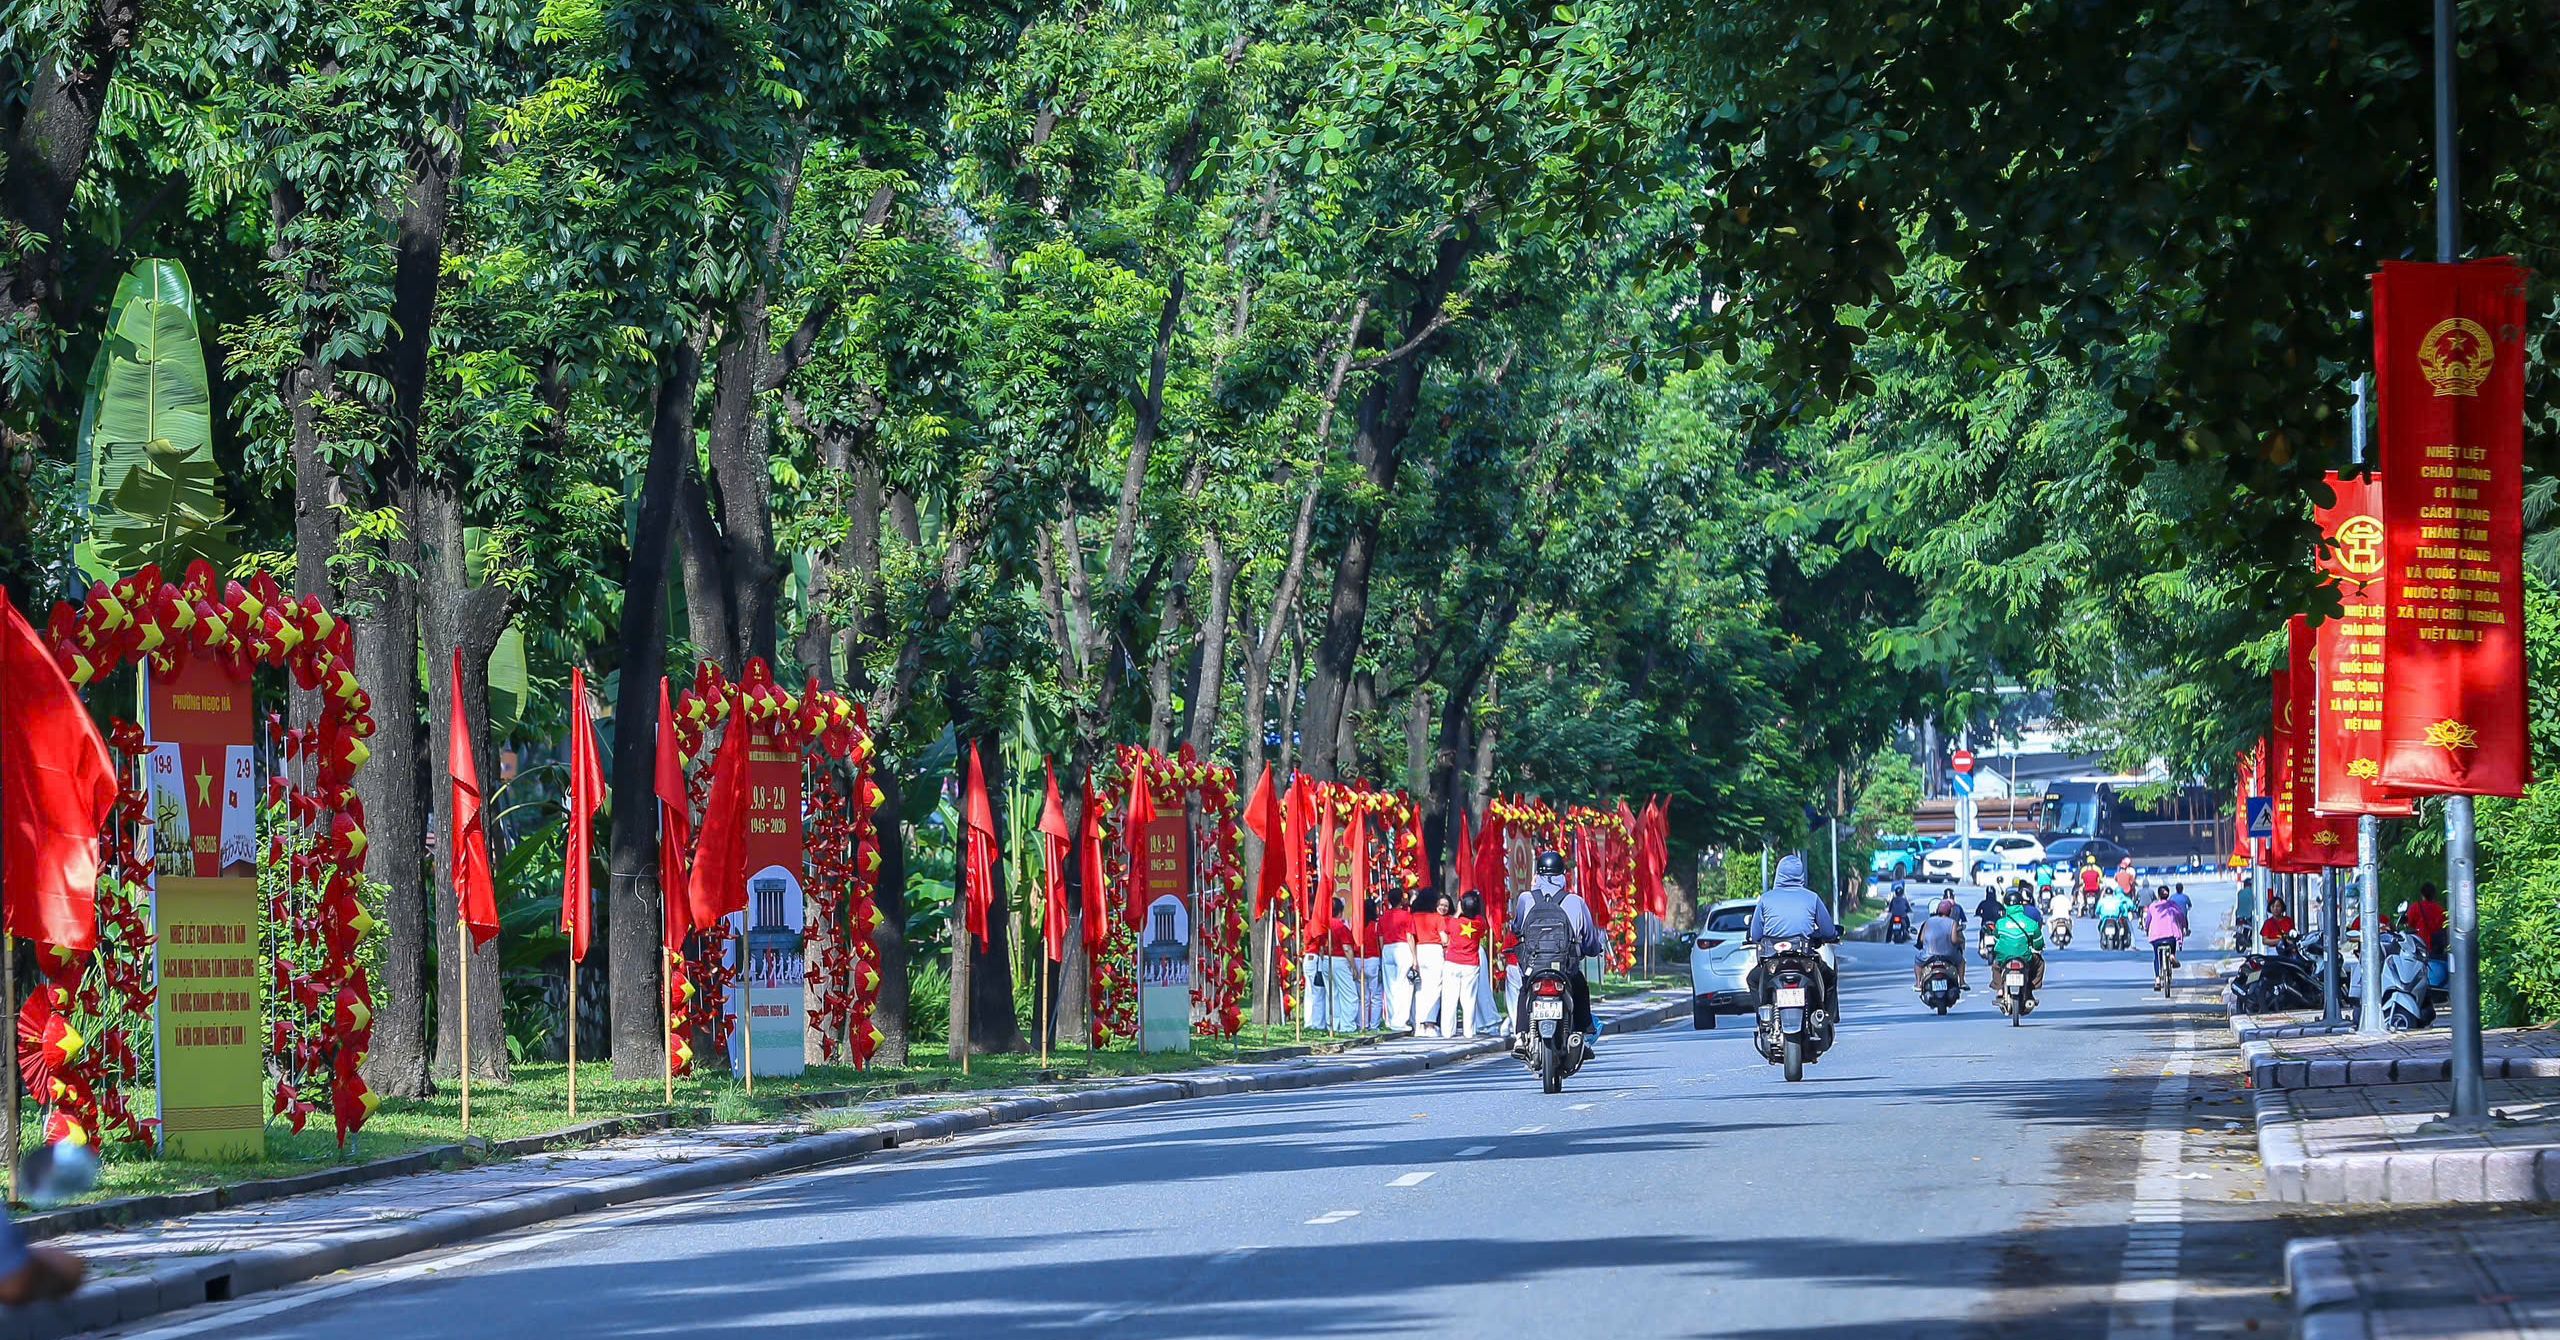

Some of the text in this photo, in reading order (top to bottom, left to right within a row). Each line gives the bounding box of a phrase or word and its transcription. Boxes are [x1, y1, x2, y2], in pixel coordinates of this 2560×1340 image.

[2426, 444, 2487, 462] NHIỆT LIỆT
[2421, 464, 2491, 480] CHÀO MỪNG
[2434, 486, 2478, 500] 81 NĂM
[2420, 505, 2490, 522] CÁCH MẠNG
[2421, 525, 2488, 541] THÁNG TÁM
[2416, 545, 2490, 561] THÀNH CÔNG
[2406, 564, 2500, 583] VÀ QUỐC KHÁNH
[2403, 585, 2500, 603] NƯỚC CỘNG HÒA
[2344, 604, 2384, 620] NHIỆT LIỆT
[2397, 605, 2505, 624] XÃ HỘI CHỦ NGHĨA
[2341, 622, 2363, 636] CHÀO
[2420, 626, 2482, 642] VIỆT NAM !
[2361, 642, 2380, 655] NĂM
[2340, 659, 2361, 674] QUỐC
[2332, 679, 2355, 692] NƯỚC
[2357, 679, 2378, 694] CỘNG
[172, 692, 231, 714] PHƯỜNG NGỌC HÀ
[2330, 697, 2342, 710] XÃ
[2343, 698, 2357, 713] HỘI
[2358, 697, 2374, 711] CHỦ
[2344, 716, 2362, 732] VIỆT
[154, 755, 172, 774] 19-8
[237, 759, 250, 778] 2-9
[750, 785, 766, 810] 9.8
[774, 786, 786, 810] 2.9
[751, 818, 766, 833] 1945
[771, 818, 786, 833] 2026
